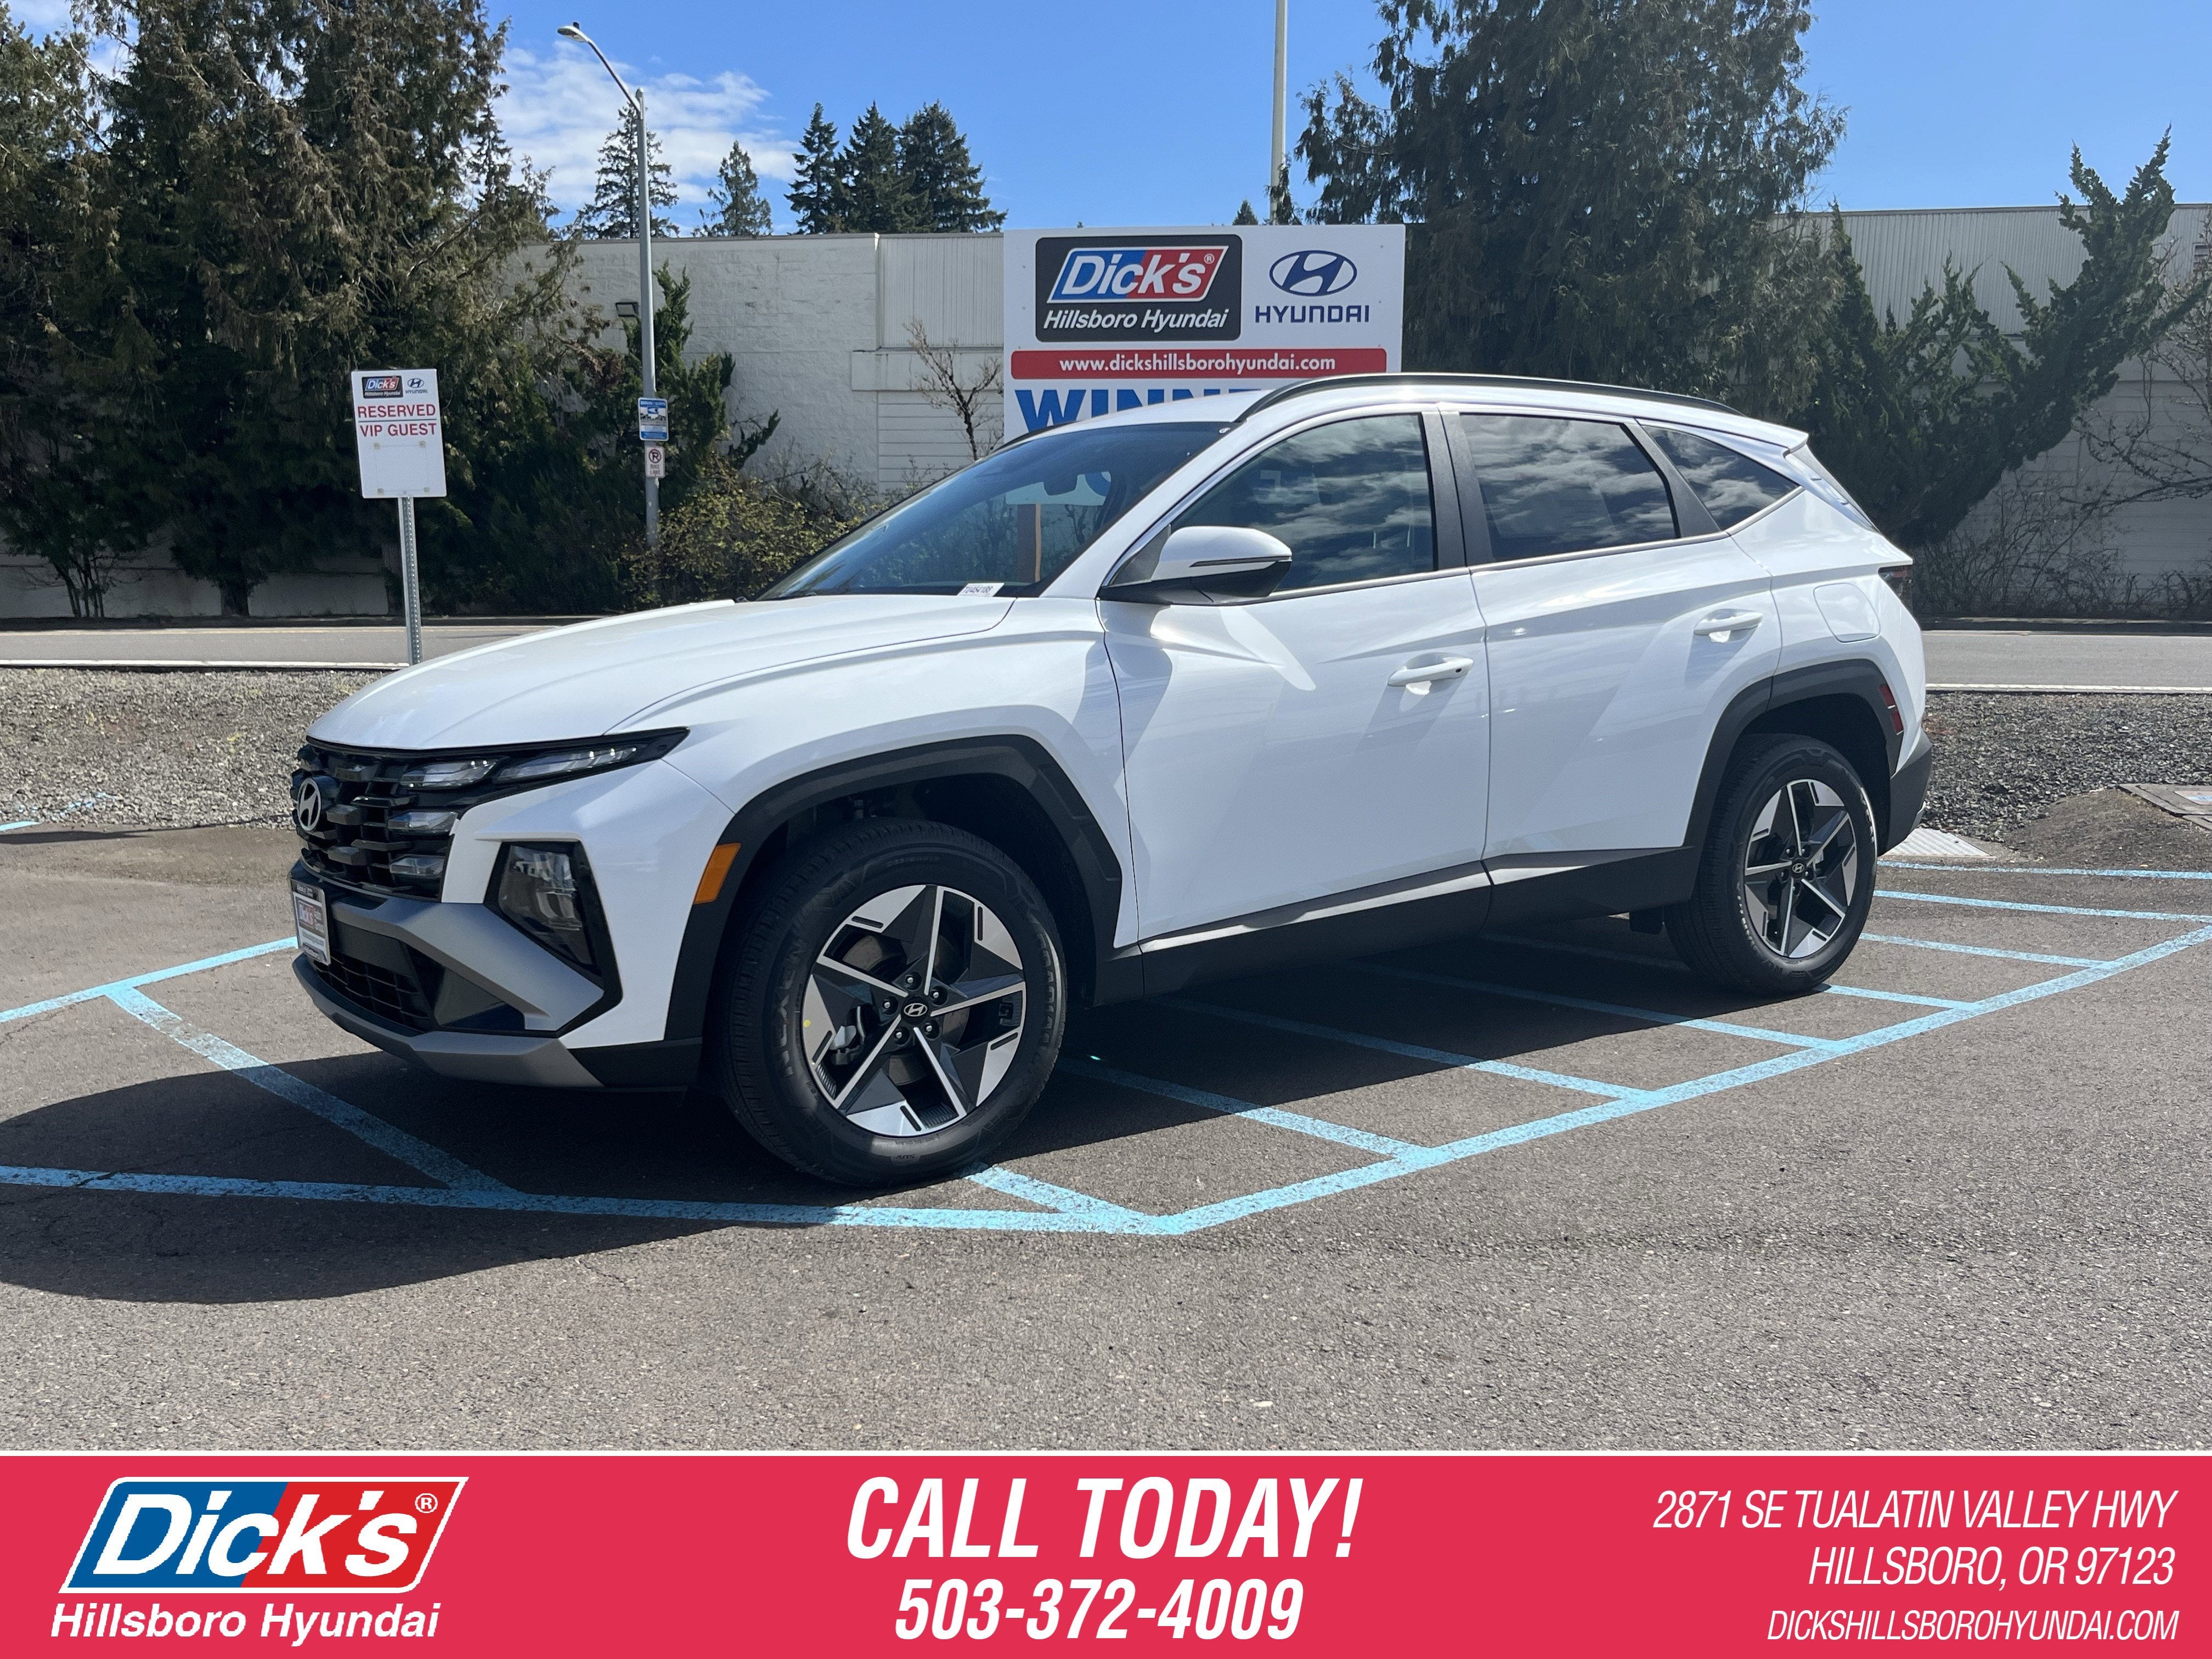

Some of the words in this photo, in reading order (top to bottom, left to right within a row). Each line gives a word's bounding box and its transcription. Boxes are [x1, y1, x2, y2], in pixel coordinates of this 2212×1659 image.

[1043, 310, 1138, 329] Hillsboro
[1140, 308, 1230, 333] Hyundai
[1255, 304, 1370, 324] HYUNDAI
[1059, 353, 1336, 373] www.dickshillsborohyundai.com
[358, 404, 436, 418] RESERVED
[360, 425, 382, 437] VIP
[388, 423, 437, 436] GUEST
